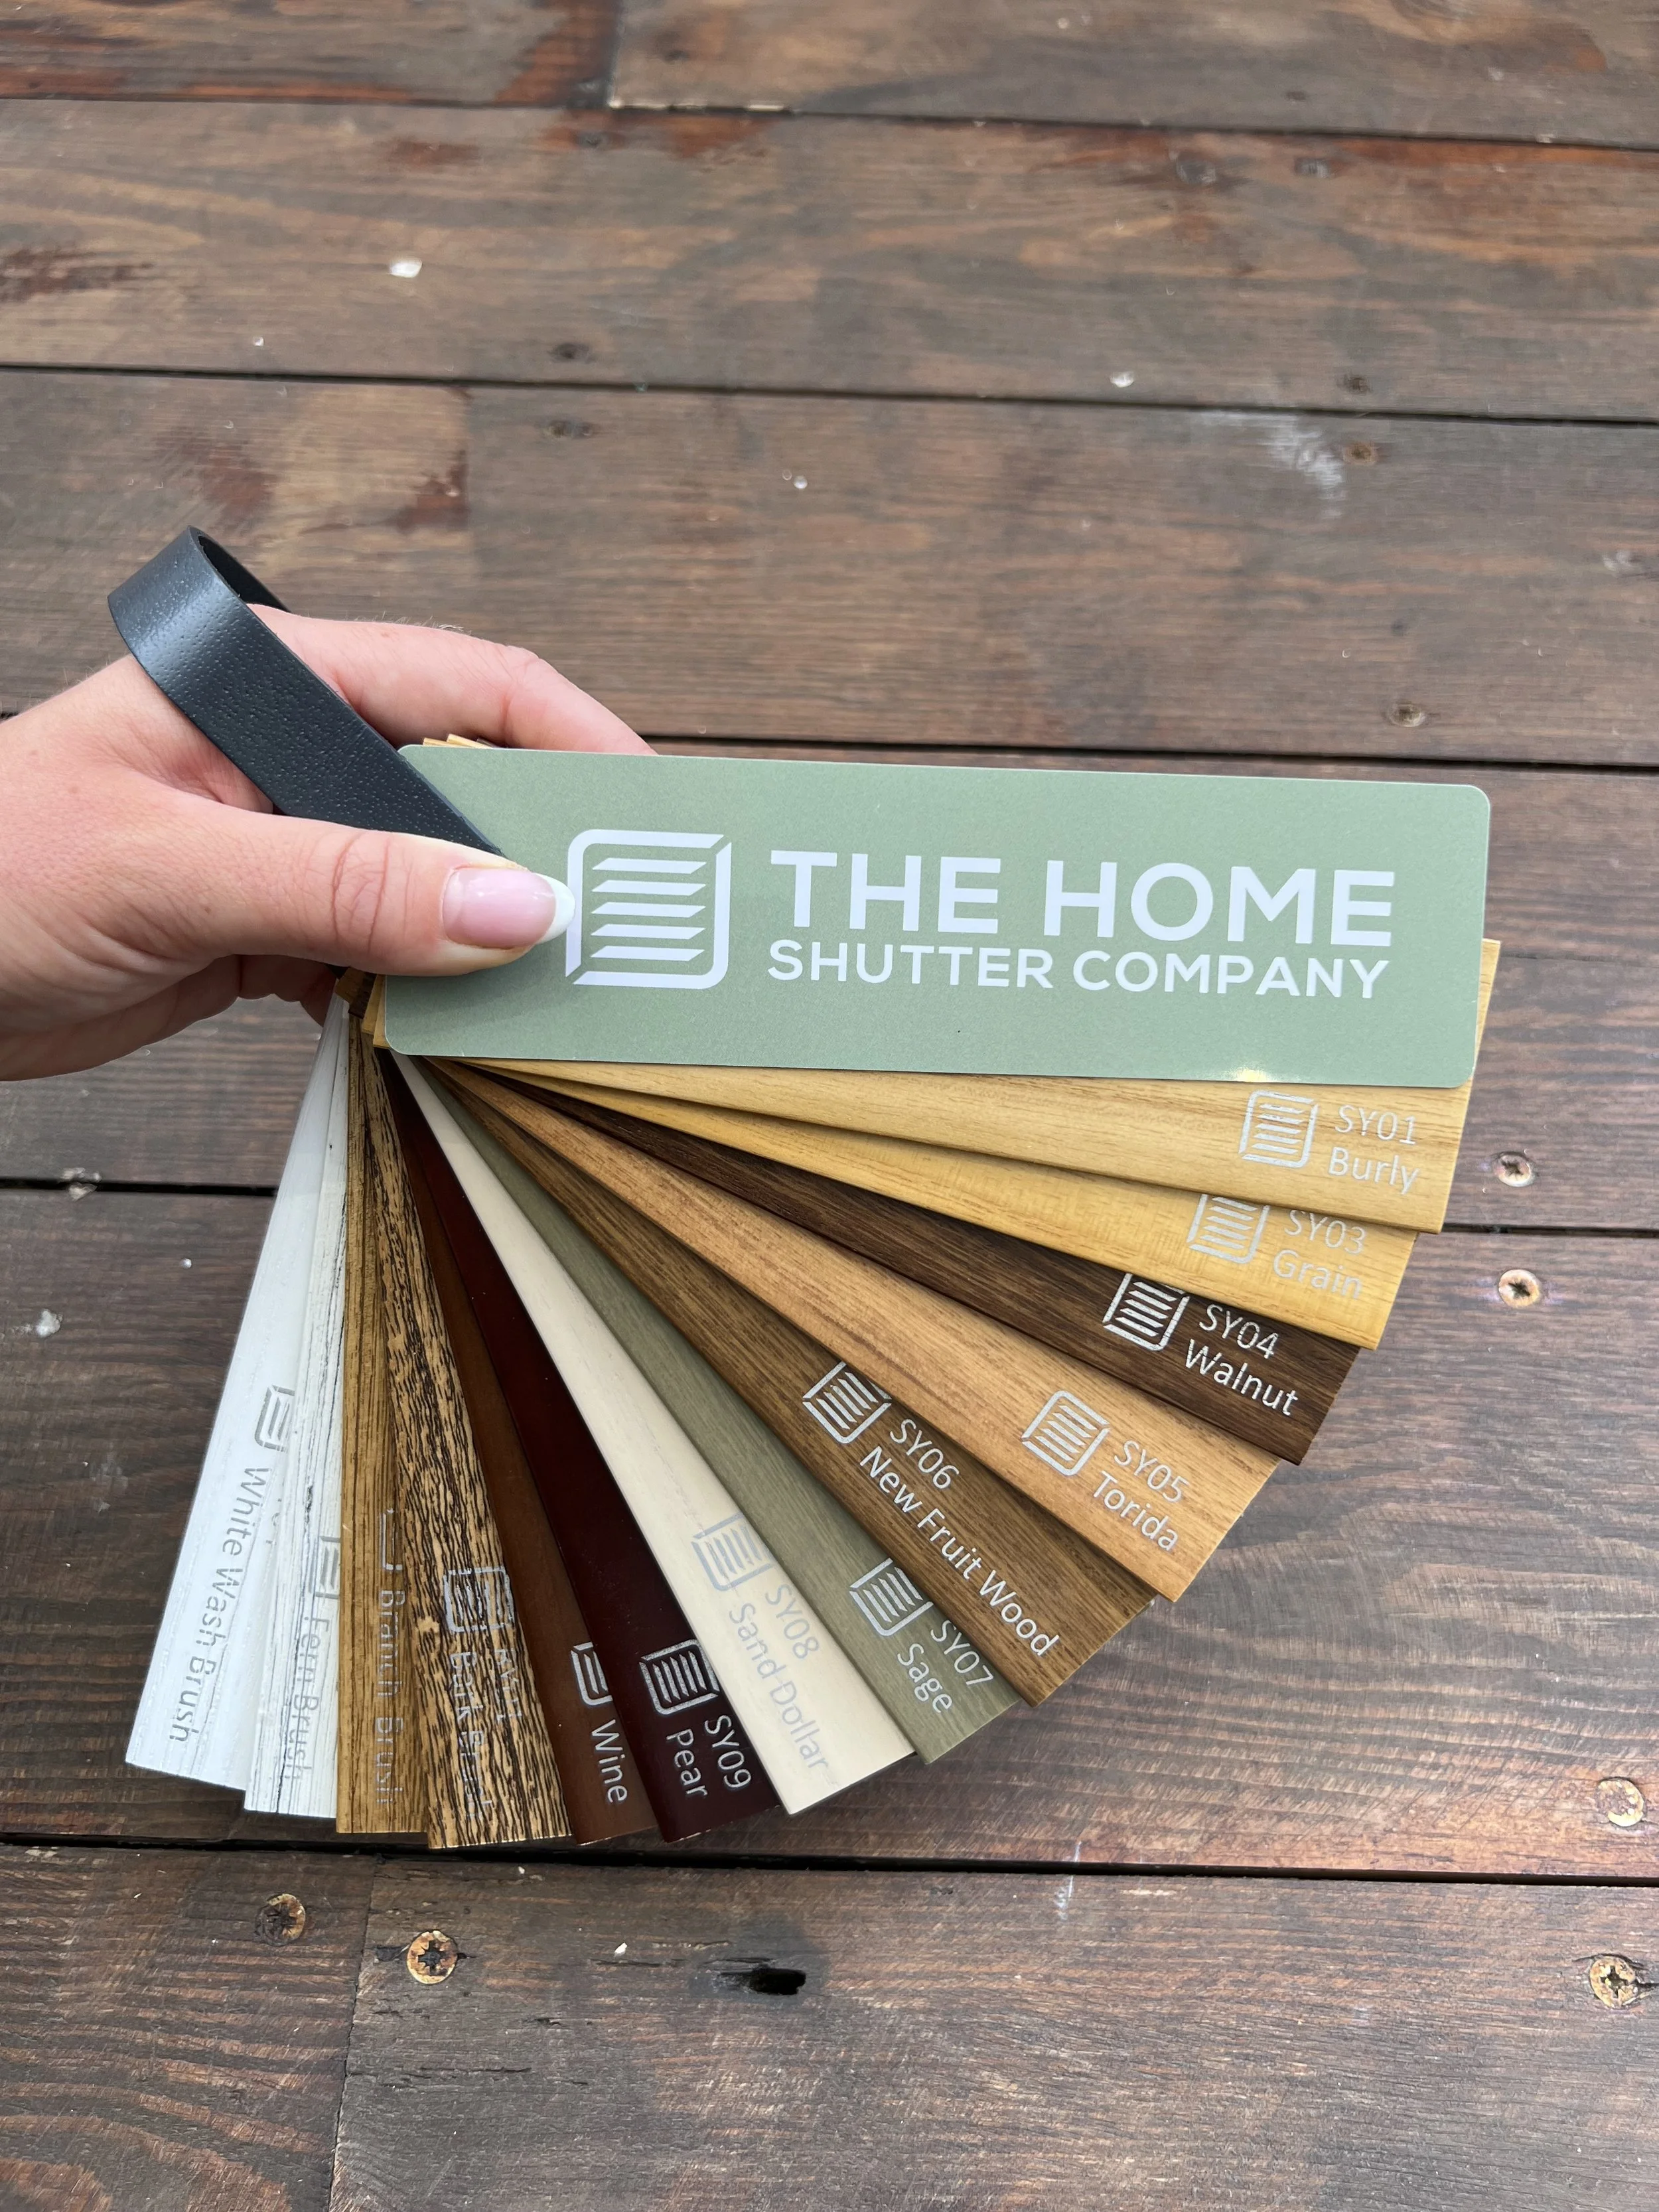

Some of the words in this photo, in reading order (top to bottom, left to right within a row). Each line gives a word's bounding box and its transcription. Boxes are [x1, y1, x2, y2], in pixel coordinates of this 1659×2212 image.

[770, 850, 1001, 934] THE
[1044, 860, 1396, 947] HOME
[767, 939, 1054, 988] SHUTTER
[1072, 950, 1390, 999] COMPANY
[1334, 1104, 1416, 1145] SY01
[1327, 1147, 1420, 1195] Burly
[1283, 1209, 1367, 1256] SY03
[1273, 1249, 1363, 1300] Grain
[1198, 1304, 1280, 1359] SY04
[1184, 1339, 1298, 1416] Walnut
[889, 1418, 960, 1489] SY06
[1114, 1439, 1189, 1503] SY05
[222, 1467, 270, 1556] White
[1092, 1471, 1179, 1552] Torida
[859, 1446, 923, 1513] New
[916, 1508, 982, 1580] Fruit
[978, 1569, 1060, 1657] Wood
[196, 1567, 244, 1647] Wash
[378, 1589, 406, 1697] Branch
[764, 1584, 821, 1660] SY08
[296, 1617, 330, 1683] Fern
[729, 1602, 787, 1680] Sand
[768, 1680, 830, 1771] Dollar
[897, 1643, 954, 1714] Sage
[930, 1619, 994, 1686] SY07
[169, 1655, 217, 1743] Brush
[284, 1694, 321, 1781] Brush
[376, 1717, 404, 1804] Brush
[591, 1718, 628, 1804] Wine
[666, 1728, 708, 1797] Pear
[704, 1714, 752, 1789] SY09
